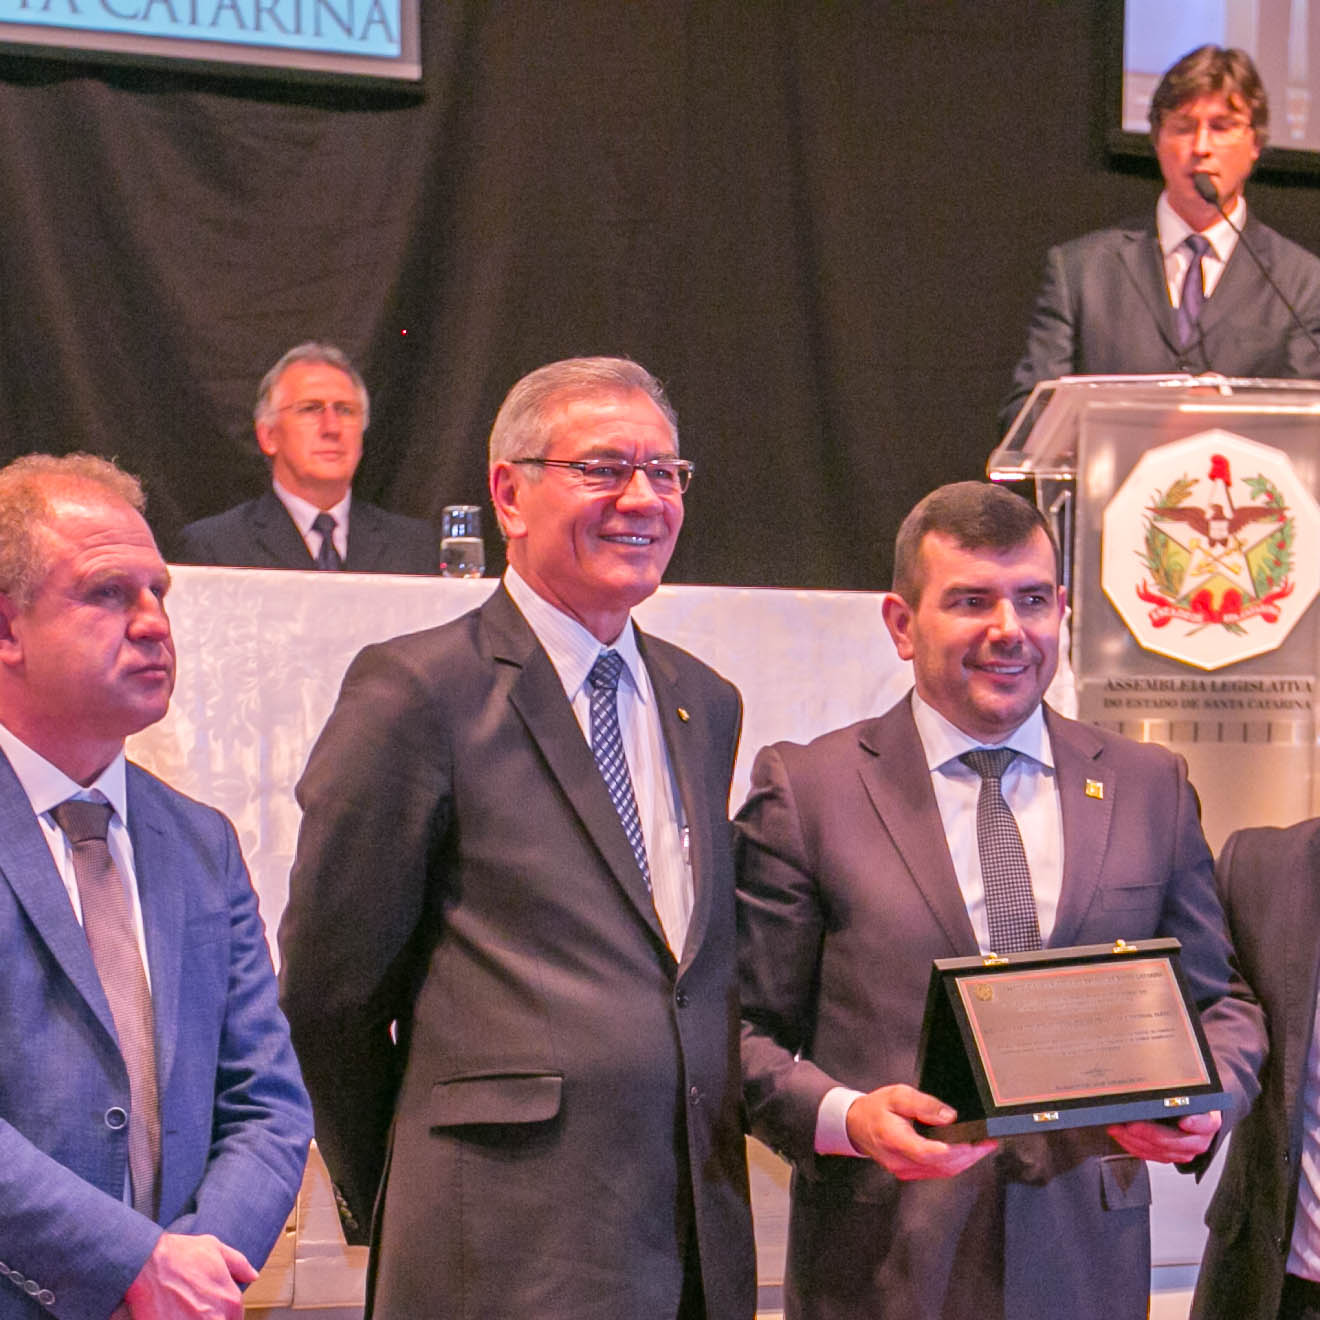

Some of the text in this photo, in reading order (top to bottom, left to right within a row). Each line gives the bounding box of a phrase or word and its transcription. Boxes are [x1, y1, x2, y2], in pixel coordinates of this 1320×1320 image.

[1104, 678, 1312, 692] ASSEMBLEIA LEGISLATIVA
[1104, 698, 1312, 709] DO ESTADO DE SANTA CATARINA
